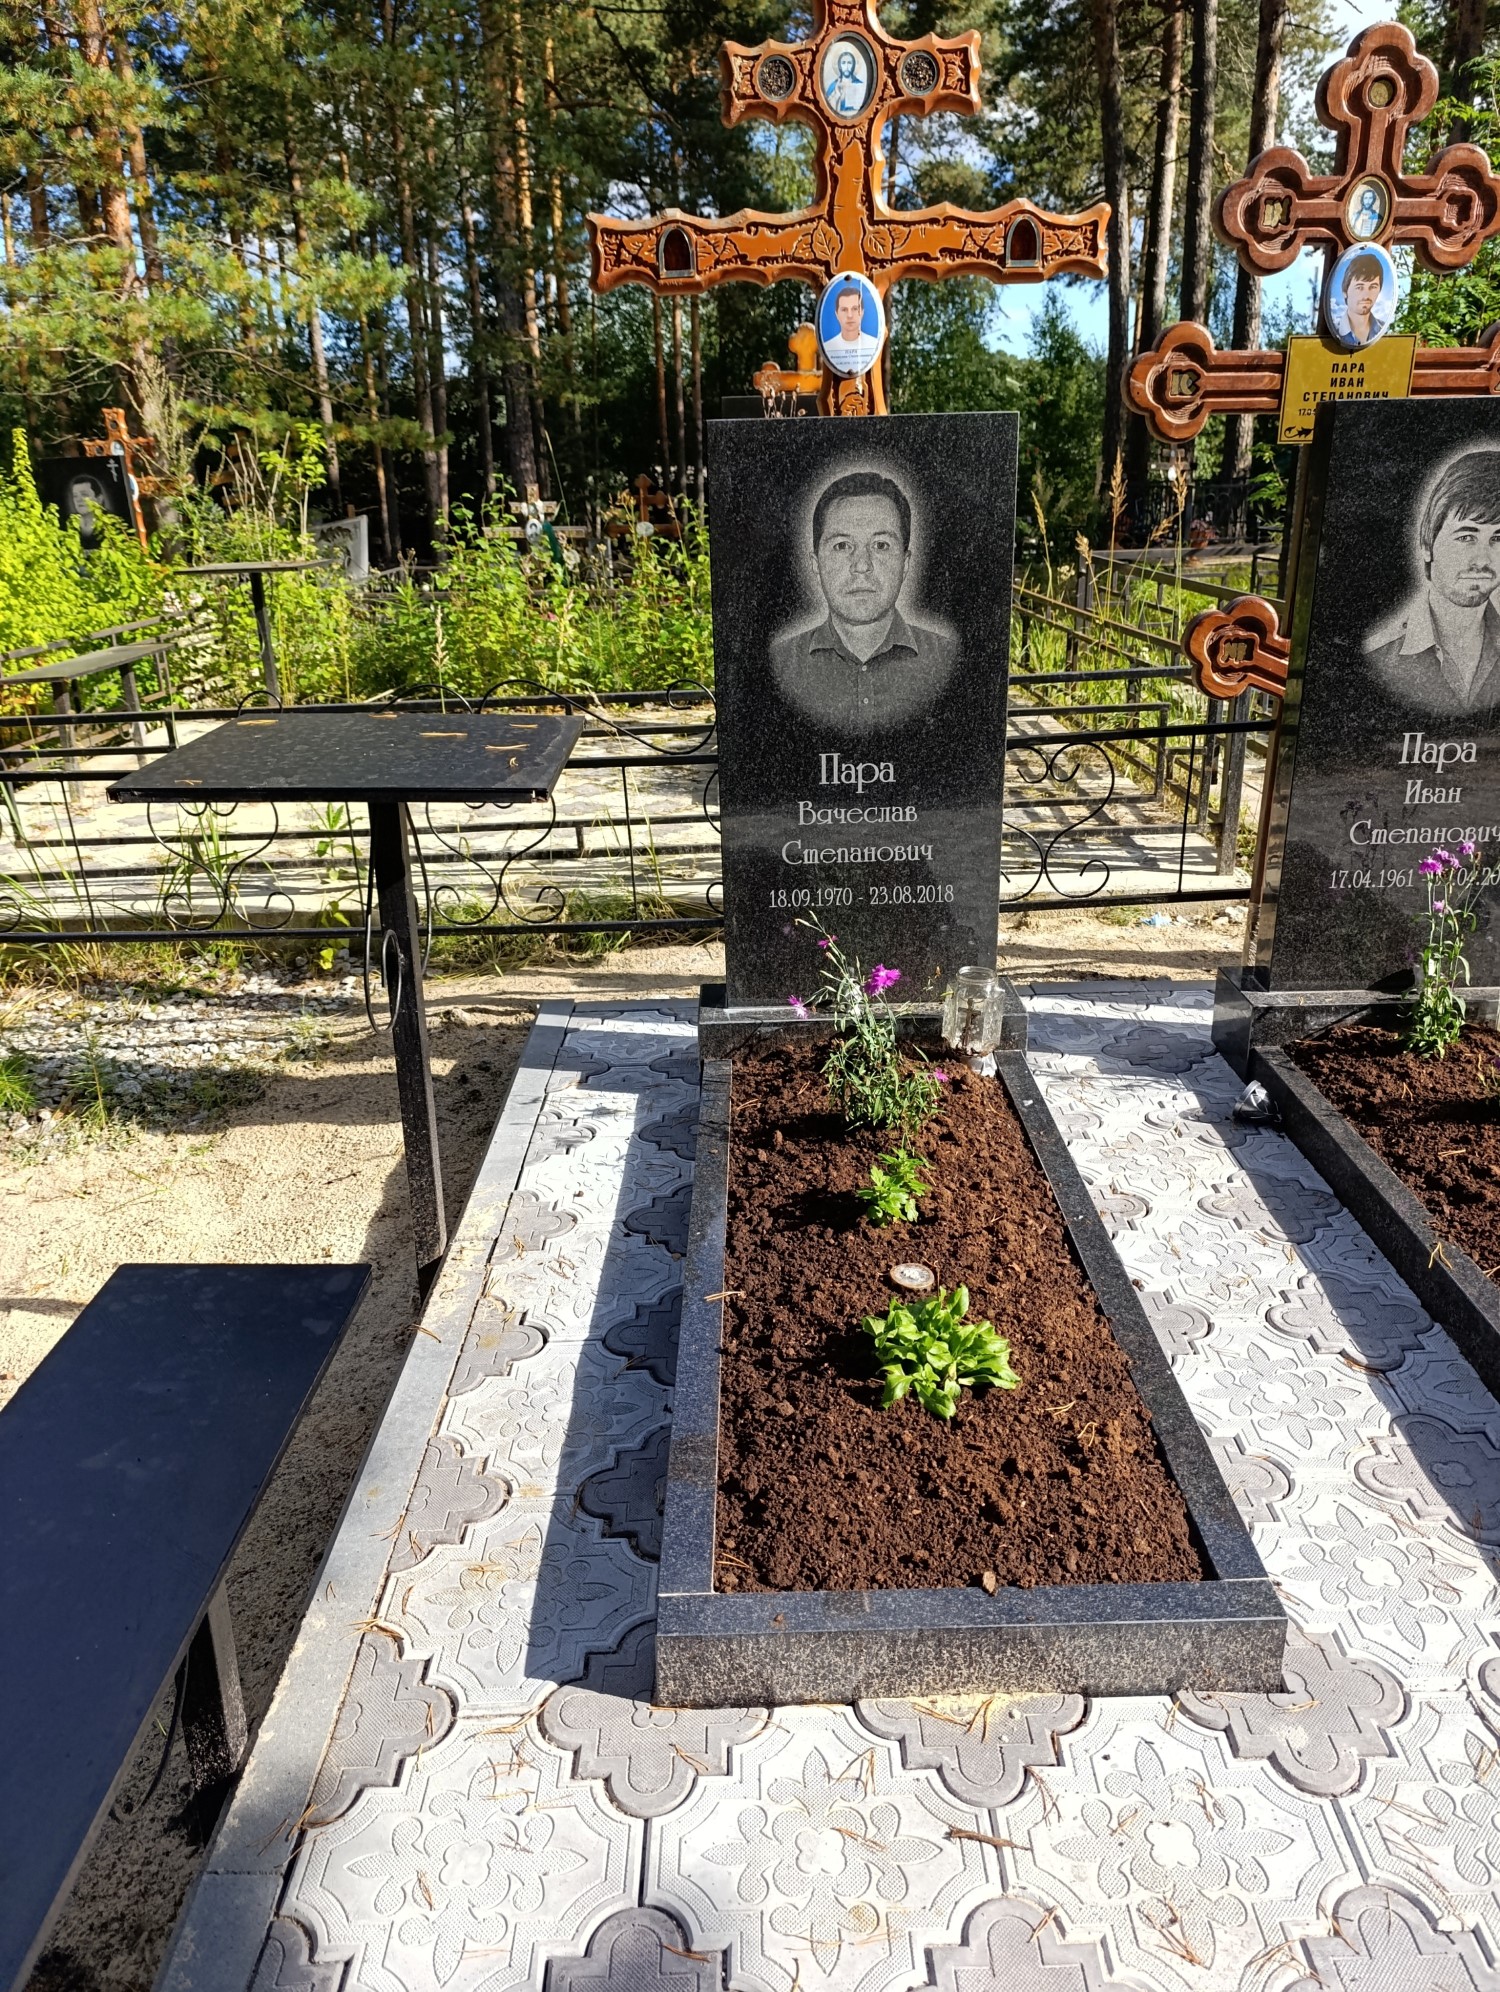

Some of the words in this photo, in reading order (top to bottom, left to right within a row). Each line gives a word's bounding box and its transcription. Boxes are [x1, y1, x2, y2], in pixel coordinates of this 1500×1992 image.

[1331, 363, 1365, 373] ПАРА
[1330, 377, 1365, 387] ИВАН
[1303, 391, 1389, 402] СТЕПАНОВИЧ
[1399, 732, 1477, 773] Пара
[819, 753, 896, 793] Пара
[1403, 779, 1462, 805] Иван
[797, 800, 918, 826] Вячеслав
[781, 840, 934, 865] Степанович
[1329, 868, 1414, 889] 17.04.1961
[769, 887, 853, 908] 18.09.1970
[869, 884, 954, 906] 23.08.2018
